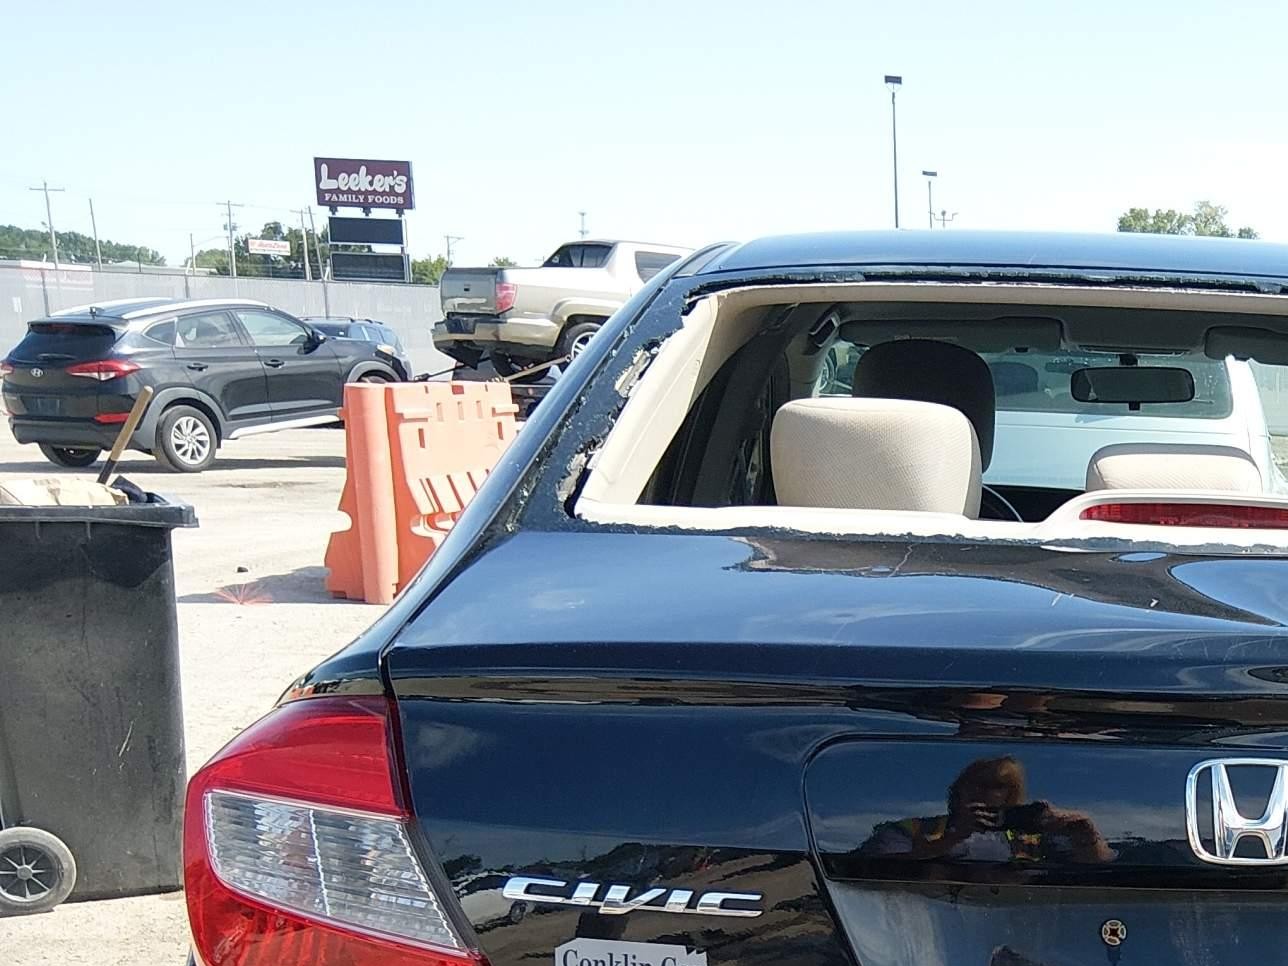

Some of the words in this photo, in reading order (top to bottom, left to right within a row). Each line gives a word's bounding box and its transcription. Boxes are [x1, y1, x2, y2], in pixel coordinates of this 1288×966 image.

[319, 163, 408, 194] Leeker's
[324, 192, 365, 203] FAMILY
[367, 195, 405, 205] FOODS
[502, 876, 763, 918] CIVIC
